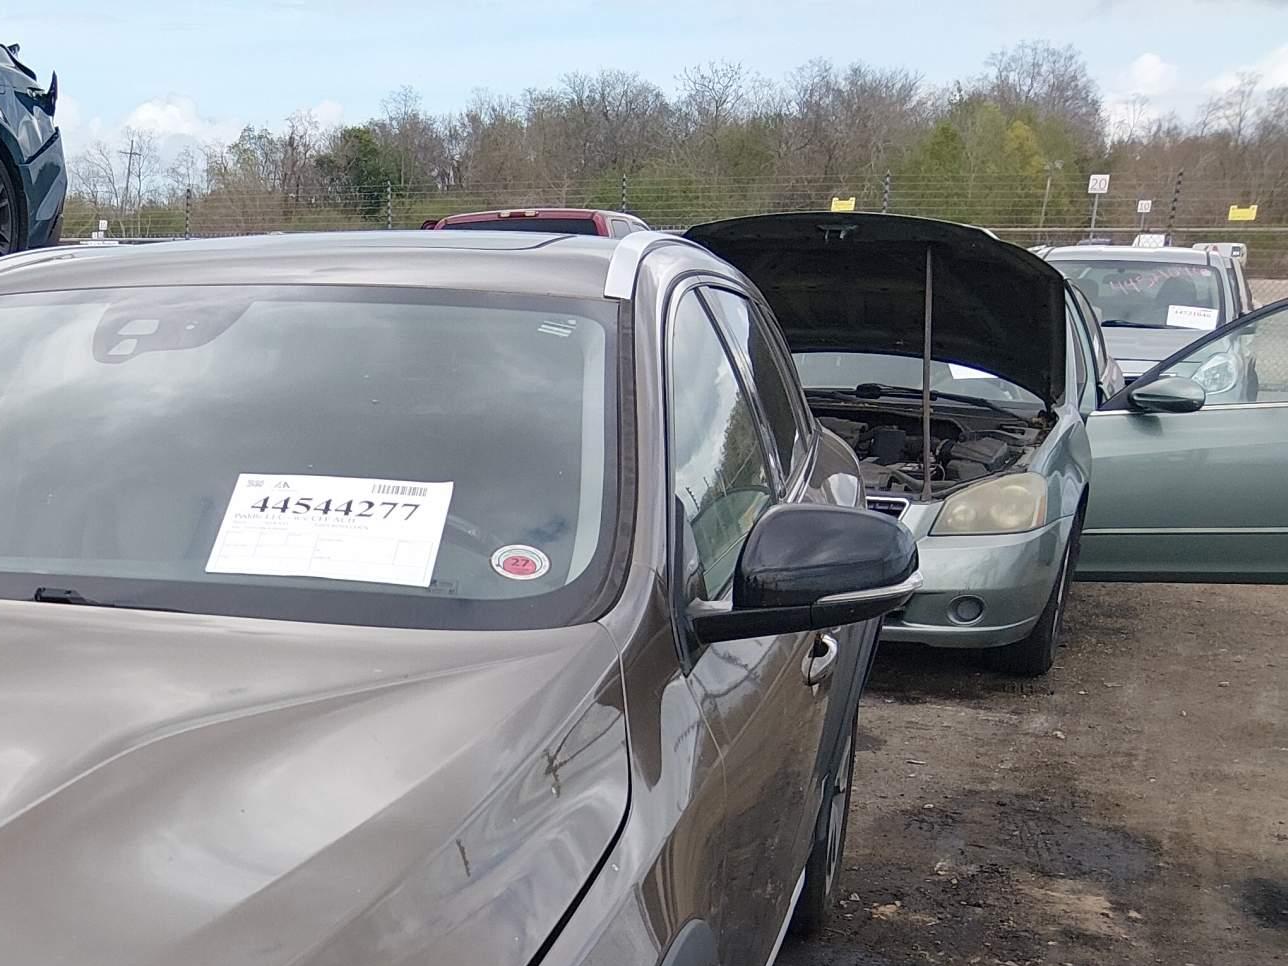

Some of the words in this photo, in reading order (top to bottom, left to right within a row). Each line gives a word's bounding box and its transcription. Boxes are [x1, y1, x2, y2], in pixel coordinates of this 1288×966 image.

[1091, 178, 1108, 191] 20
[251, 496, 421, 520] 44544277
[511, 558, 530, 567] 27
